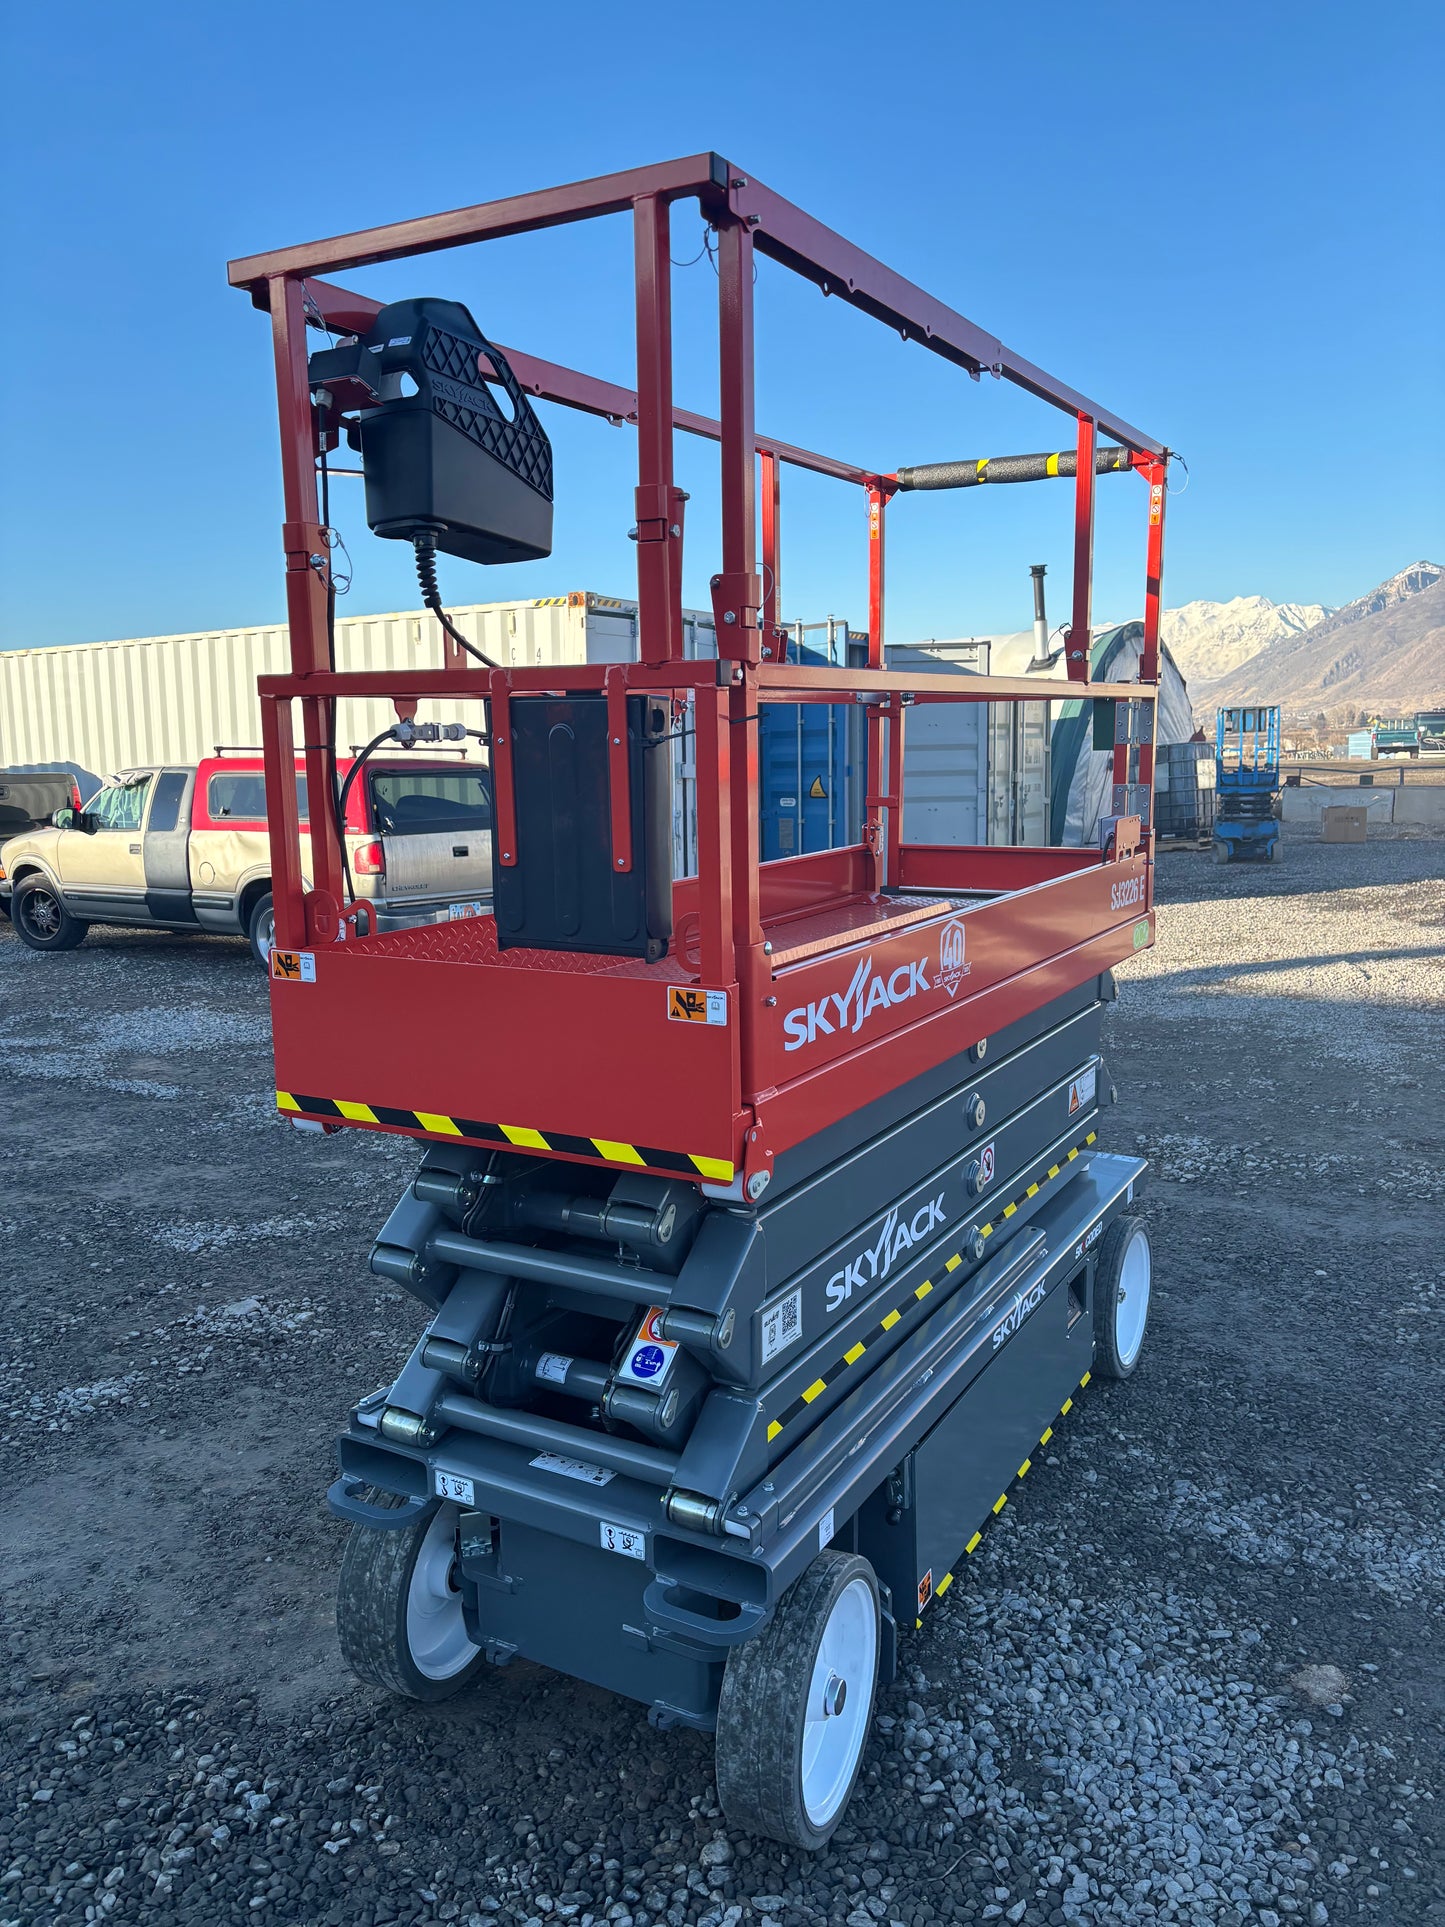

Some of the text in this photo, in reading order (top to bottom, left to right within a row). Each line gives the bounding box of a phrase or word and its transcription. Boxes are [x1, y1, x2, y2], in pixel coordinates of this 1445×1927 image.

[431, 378, 496, 414] SKYJACK
[1110, 874, 1145, 911] SJ3226 E
[943, 928, 963, 971] 40
[783, 954, 931, 1052] SKYJACK
[825, 1191, 947, 1313] SKYJACK
[992, 1278, 1047, 1350] SKYJACK
